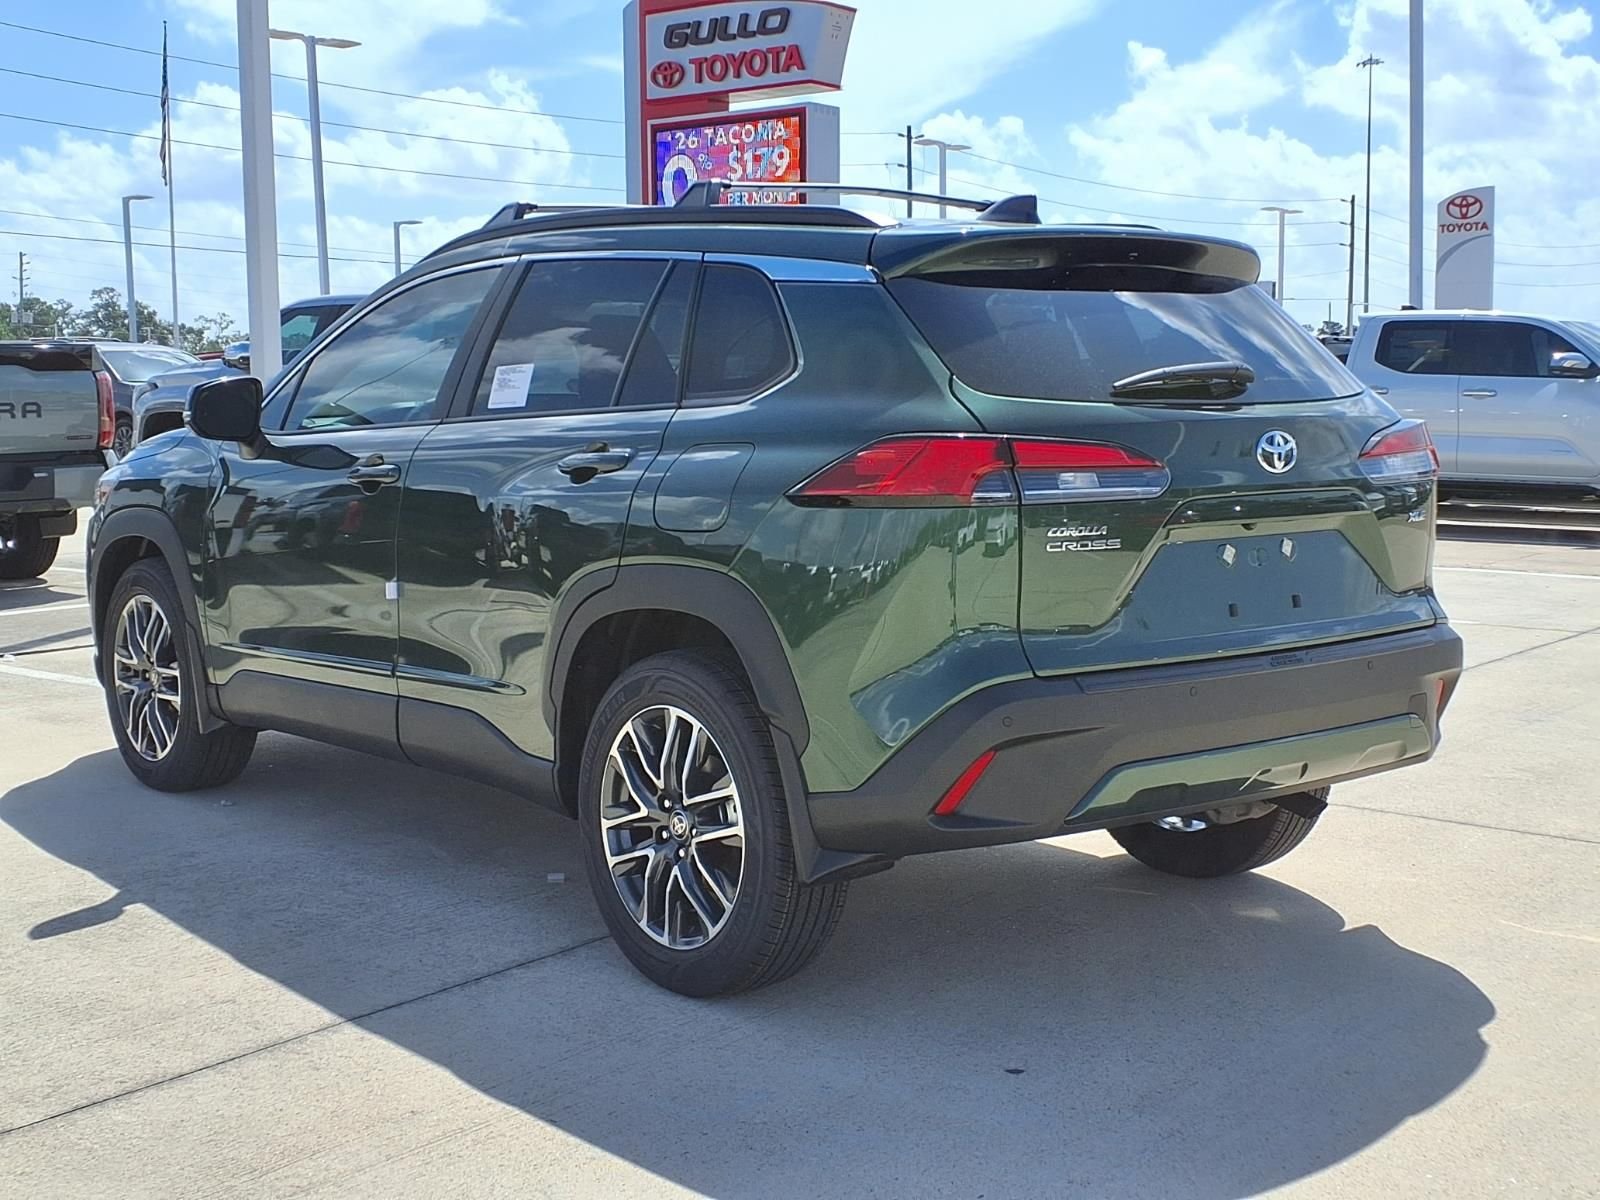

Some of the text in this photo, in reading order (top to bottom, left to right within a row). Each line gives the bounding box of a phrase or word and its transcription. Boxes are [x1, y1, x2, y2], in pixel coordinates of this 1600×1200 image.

[663, 7, 790, 49] GULLO
[689, 44, 806, 83] TOYOTA
[704, 120, 787, 147] TACOMA
[727, 143, 791, 182] $179
[727, 192, 749, 206] PER
[1440, 221, 1489, 233] TOYOTA
[1047, 525, 1108, 537] COROLLA
[1046, 539, 1122, 552] CROSS
